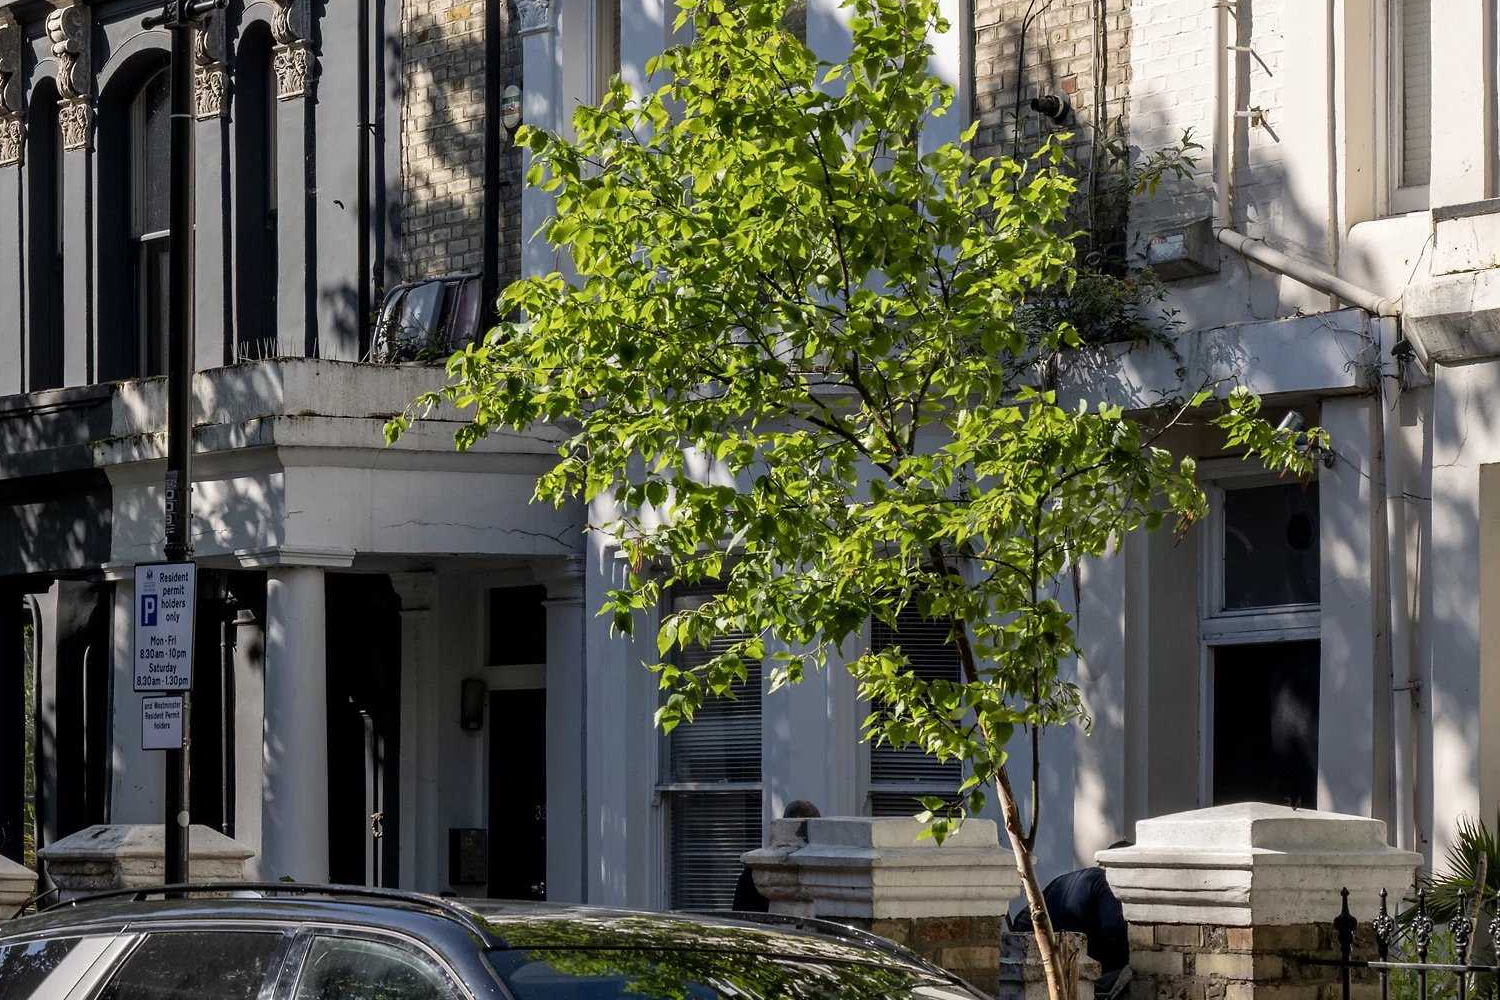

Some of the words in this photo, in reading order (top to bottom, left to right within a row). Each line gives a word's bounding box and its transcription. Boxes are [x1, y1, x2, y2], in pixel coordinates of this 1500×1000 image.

[159, 572, 189, 583] Resident
[162, 585, 185, 597] permit
[161, 599, 186, 609] holders
[144, 597, 156, 625] P
[165, 612, 181, 623] only
[149, 662, 177, 674] Saturday
